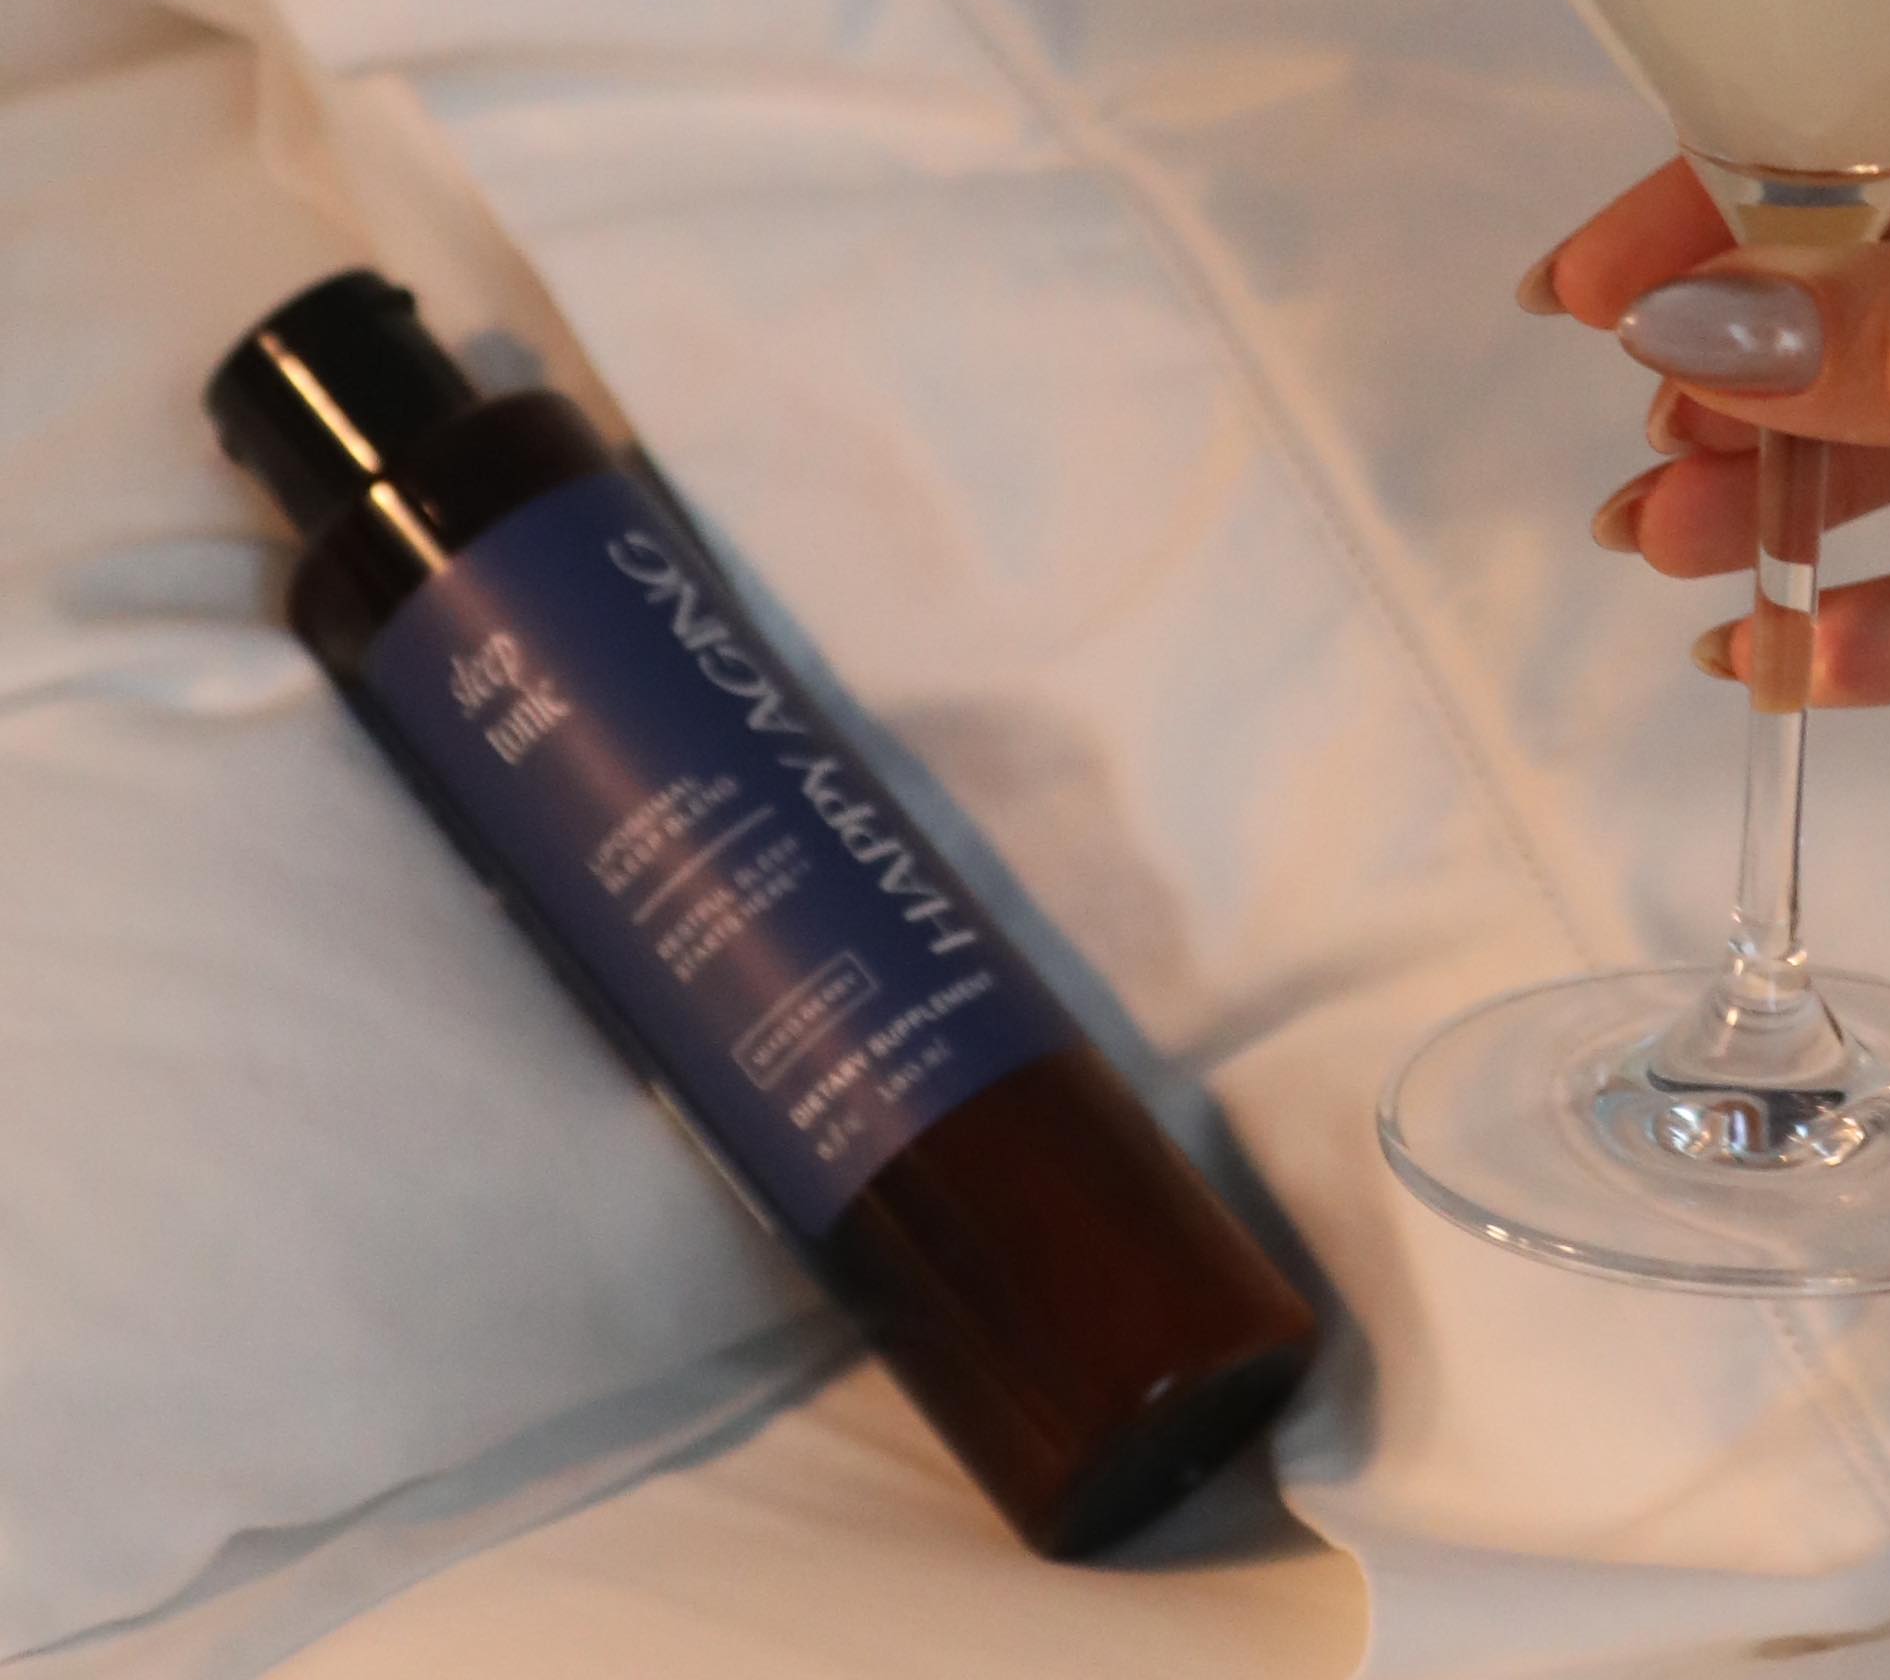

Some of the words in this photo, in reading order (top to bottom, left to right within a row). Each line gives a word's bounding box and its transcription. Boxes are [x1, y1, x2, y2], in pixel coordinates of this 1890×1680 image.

[448, 629, 519, 719] sleep
[608, 526, 807, 738] AGING
[484, 680, 572, 766] tonic
[779, 753, 977, 953] HAPPY
